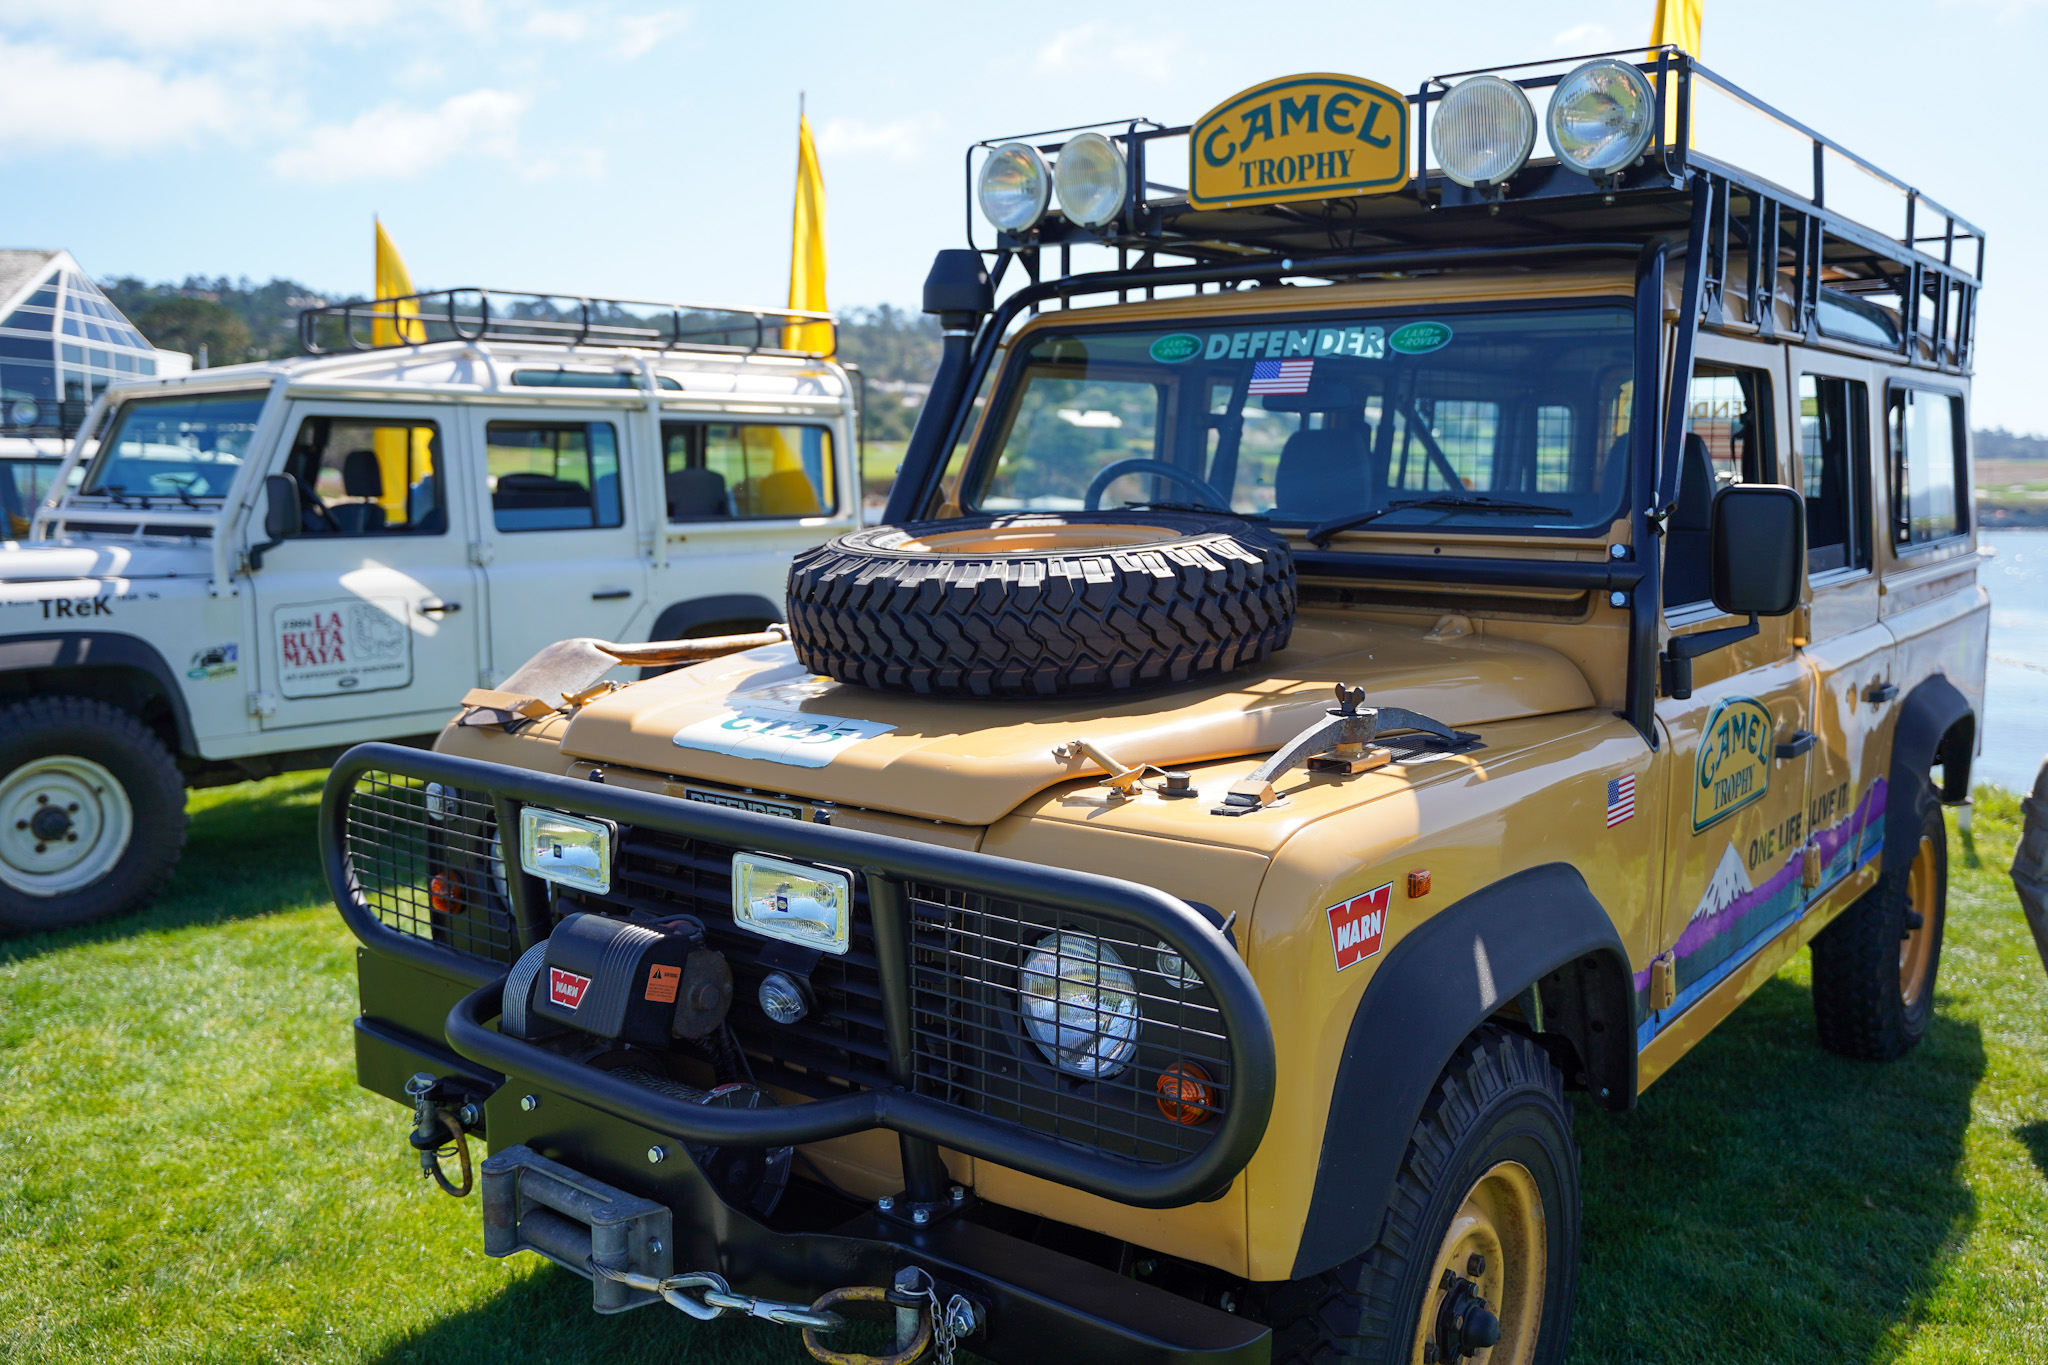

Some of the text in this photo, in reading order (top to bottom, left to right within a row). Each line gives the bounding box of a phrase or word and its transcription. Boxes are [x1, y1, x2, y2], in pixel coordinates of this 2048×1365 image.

[1203, 92, 1392, 168] CAMEL
[1239, 149, 1355, 189] TROPHY
[1204, 326, 1385, 360] DEFENDER
[282, 629, 345, 651] RUTA
[314, 611, 344, 630] LA
[283, 646, 346, 668] MAYA
[1701, 711, 1768, 789] CAMEL
[1713, 763, 1755, 811] TROPHY
[1748, 828, 1776, 871] ONE
[1778, 811, 1803, 852] LIFE
[1810, 787, 1837, 827] LIVE
[1336, 909, 1382, 952] WARN
[555, 980, 579, 998] WARN
